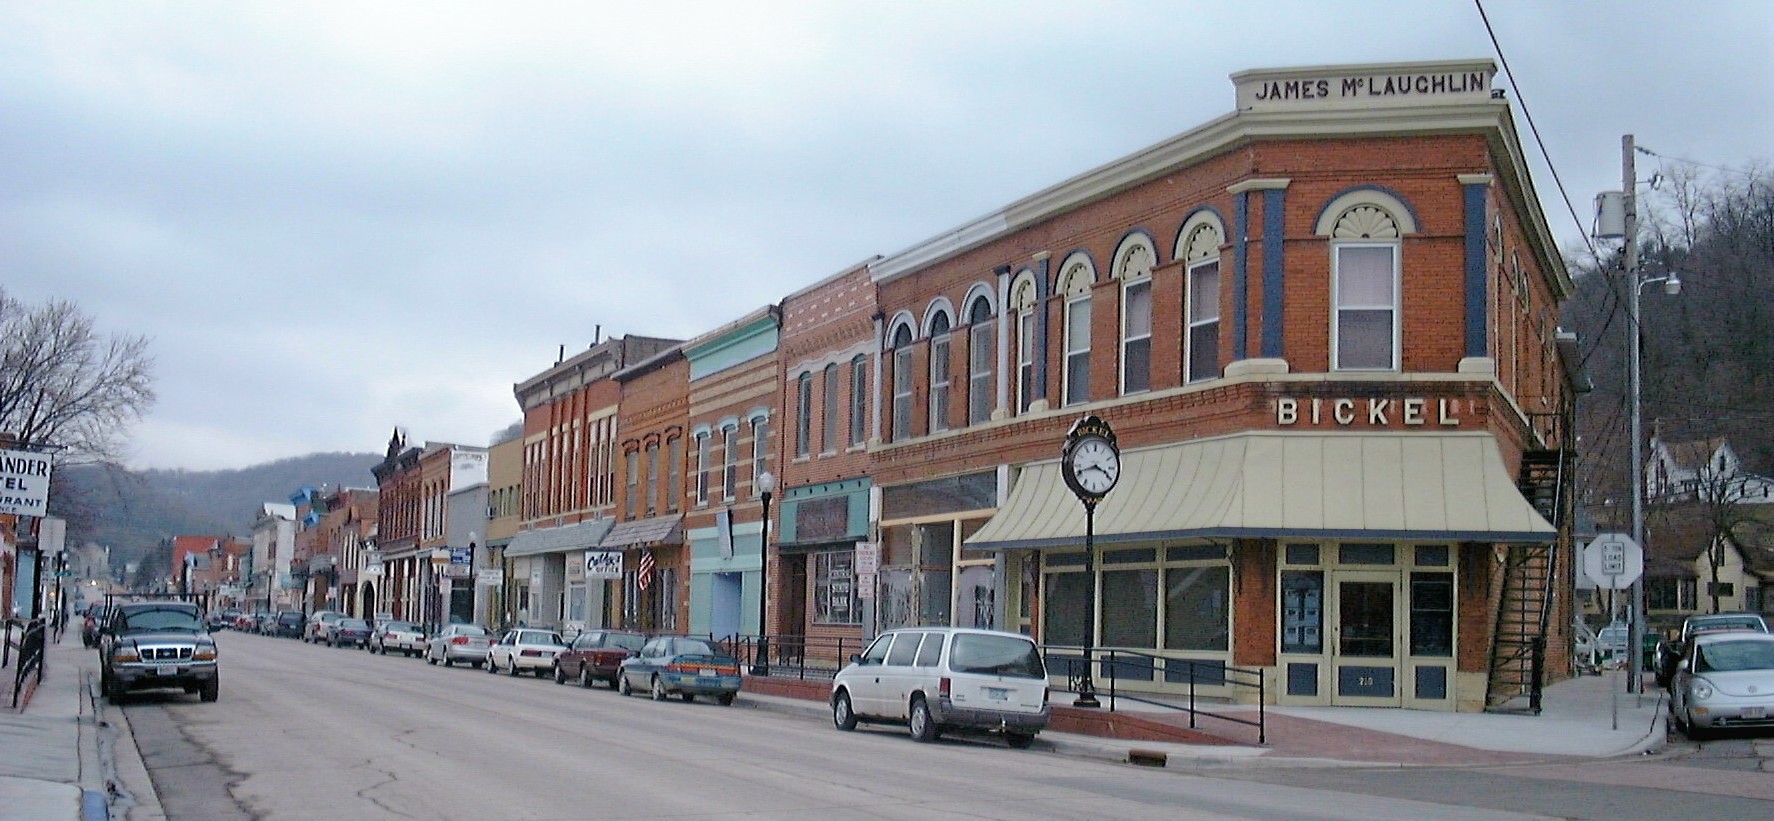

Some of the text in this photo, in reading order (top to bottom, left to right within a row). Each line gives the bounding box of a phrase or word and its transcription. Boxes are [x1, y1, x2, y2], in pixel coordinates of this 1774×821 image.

[1256, 79, 1329, 100] JAMES
[1277, 398, 1460, 425] BICKEL
[1077, 425, 1109, 437] BICKEL
